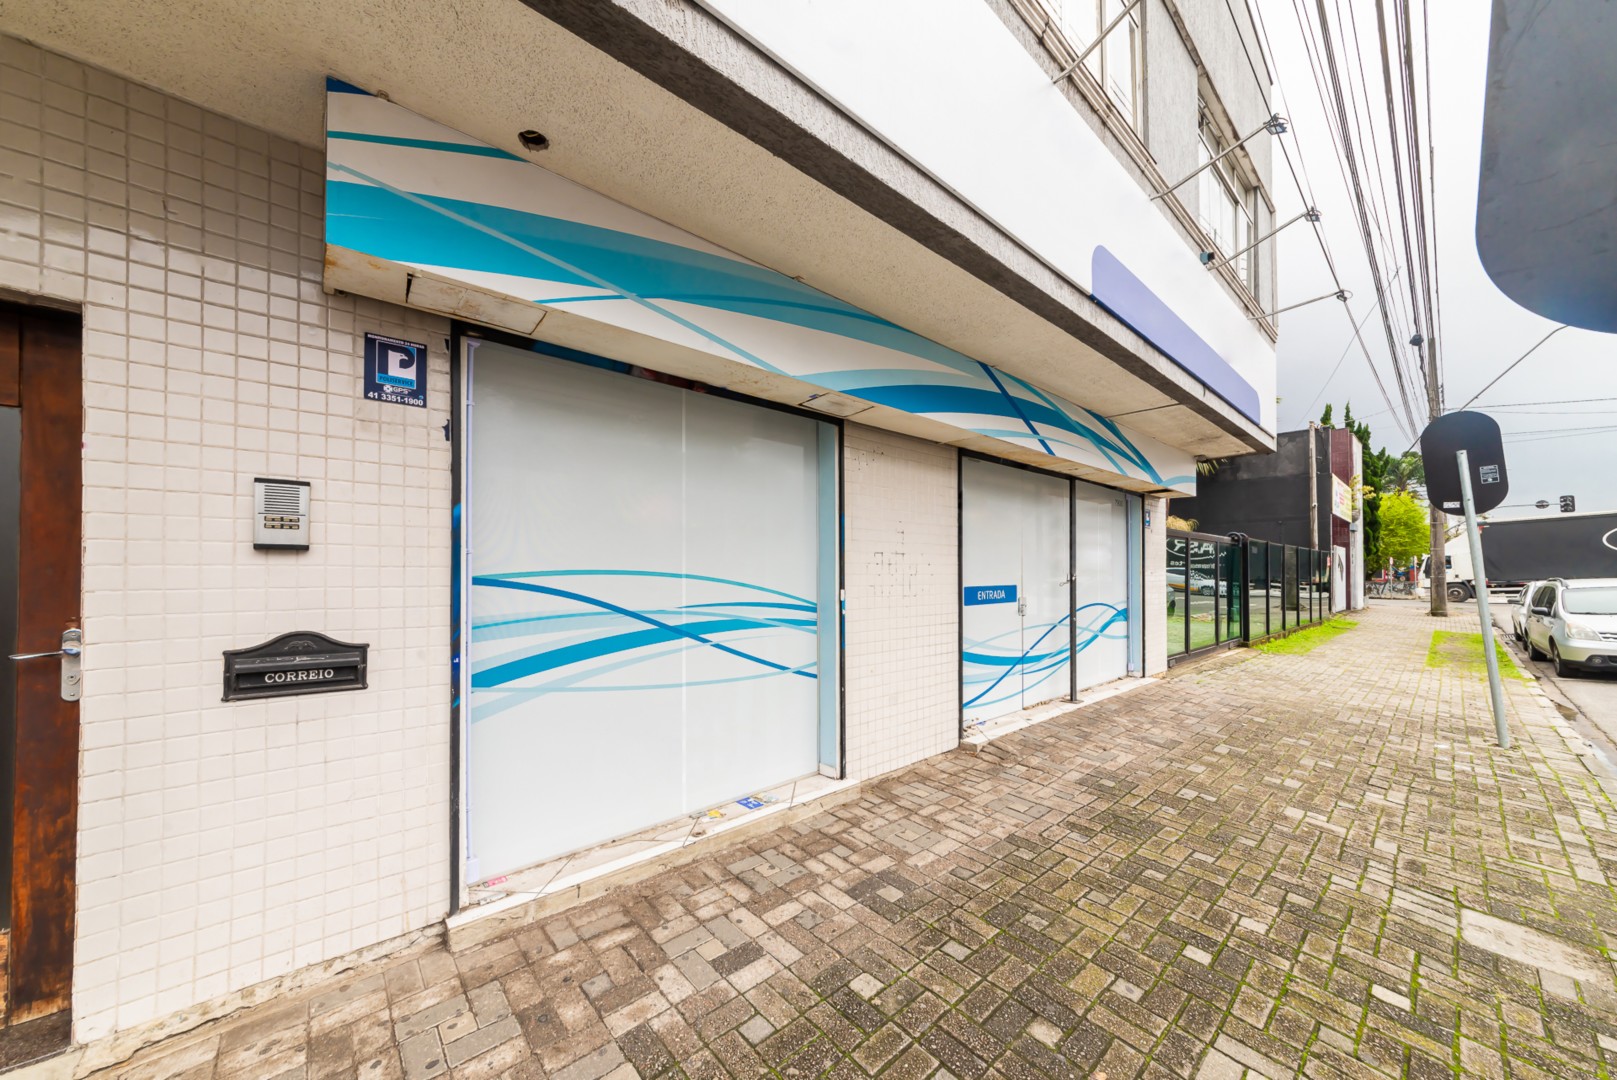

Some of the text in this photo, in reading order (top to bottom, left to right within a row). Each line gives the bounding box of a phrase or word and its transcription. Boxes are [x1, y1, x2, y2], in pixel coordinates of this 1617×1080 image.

[367, 391, 424, 406] 41 3351-1900
[977, 589, 1006, 601] ENTRADA
[264, 668, 334, 683] CORREIO
